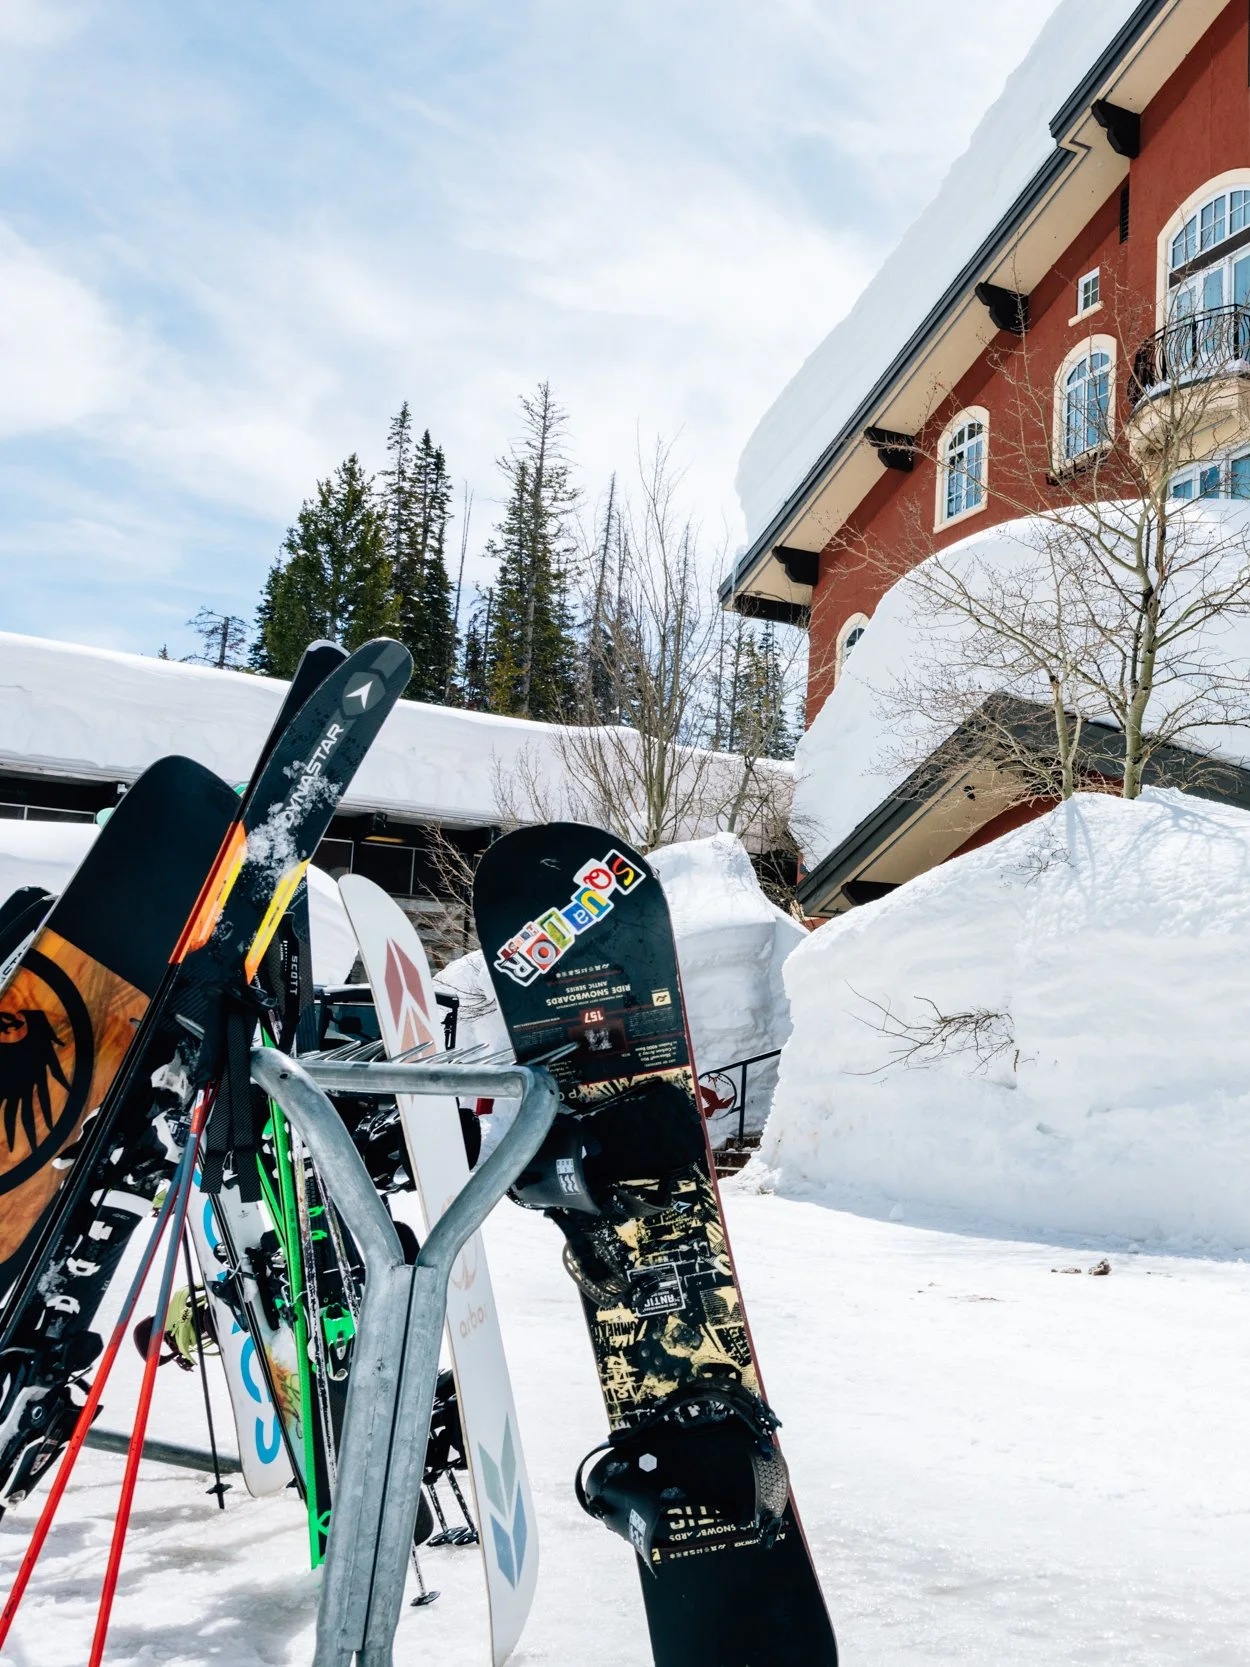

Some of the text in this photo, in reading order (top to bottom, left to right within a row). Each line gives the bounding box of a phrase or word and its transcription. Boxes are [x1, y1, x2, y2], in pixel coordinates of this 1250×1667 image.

[289, 954, 298, 995] SCOTT
[564, 979, 608, 993] ANTIC SERIES
[610, 982, 631, 994] RIDE
[545, 987, 609, 1006] SNOWBOARDS
[584, 1009, 604, 1023] 157
